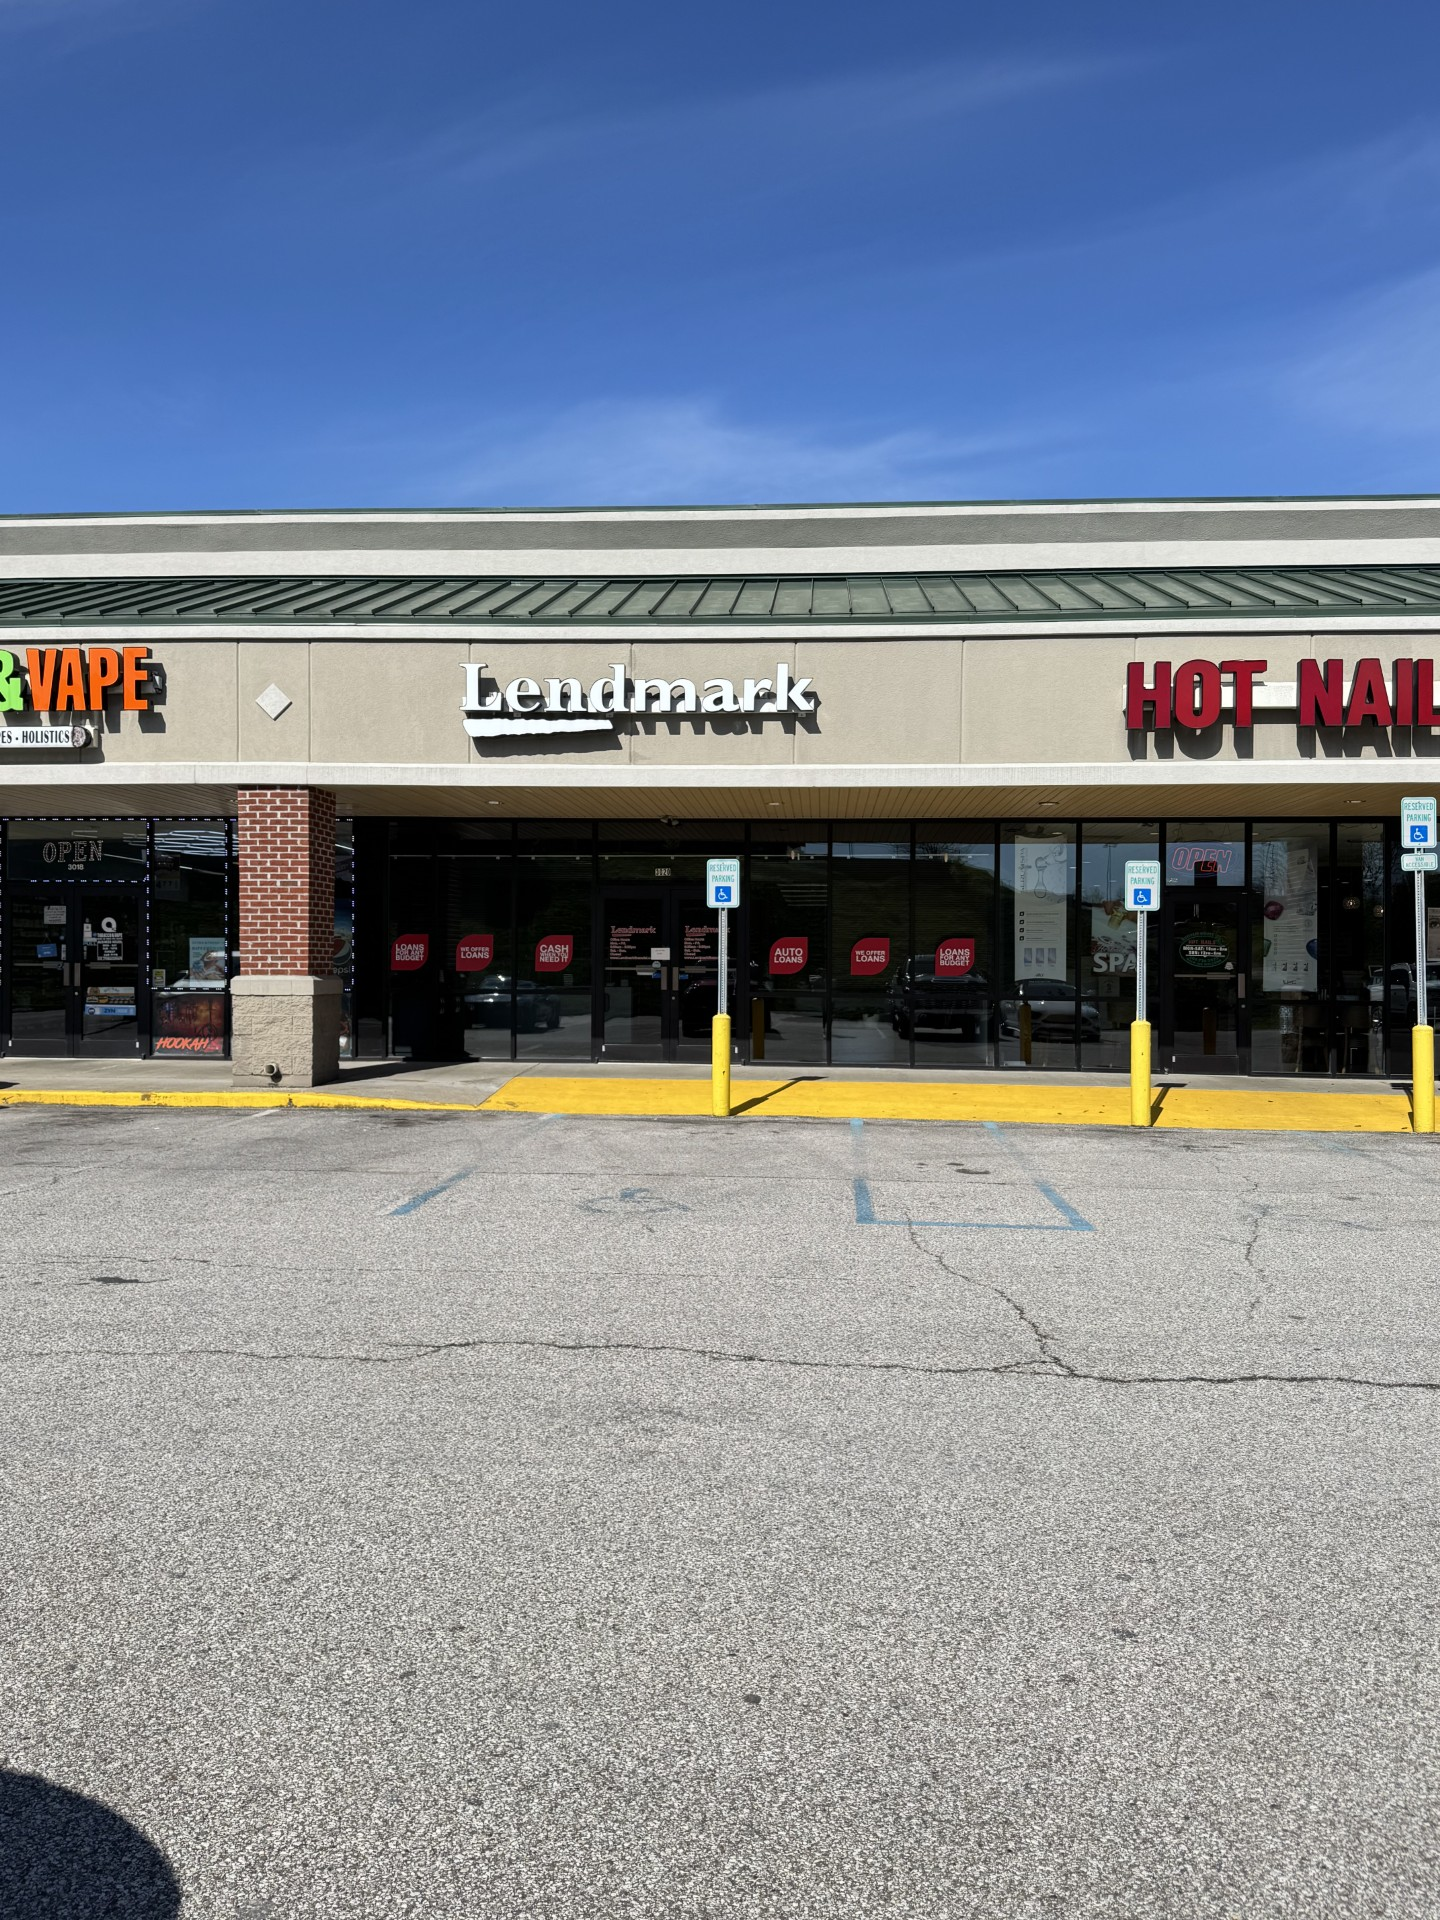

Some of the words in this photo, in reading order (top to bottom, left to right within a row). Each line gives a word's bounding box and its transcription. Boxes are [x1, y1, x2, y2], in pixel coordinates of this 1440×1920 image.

[26, 646, 148, 711] VAPE
[459, 662, 814, 712] Lendmark
[1126, 659, 1267, 729] HOT
[0, 730, 12, 743] ES
[22, 730, 70, 743] HOLISTICS
[1404, 802, 1434, 811] RESERVED
[1406, 813, 1432, 822] PARKING
[42, 840, 103, 863] OPEN
[1172, 848, 1232, 873] OPEN
[67, 863, 85, 871] 3018
[709, 863, 737, 872] RESERVED
[1127, 865, 1158, 874] RESERVED
[711, 874, 735, 883] PARKING
[1130, 876, 1155, 886] PARKING
[610, 925, 656, 934] Lendmark
[395, 943, 424, 951] LOANS
[540, 944, 569, 953] CASH
[461, 951, 489, 959] LOANS
[774, 947, 803, 957] AUTO
[940, 948, 970, 956] LOANS
[774, 956, 803, 964] LOANS
[856, 955, 885, 963] LOANS
[154, 1037, 209, 1051] HOOKAH
